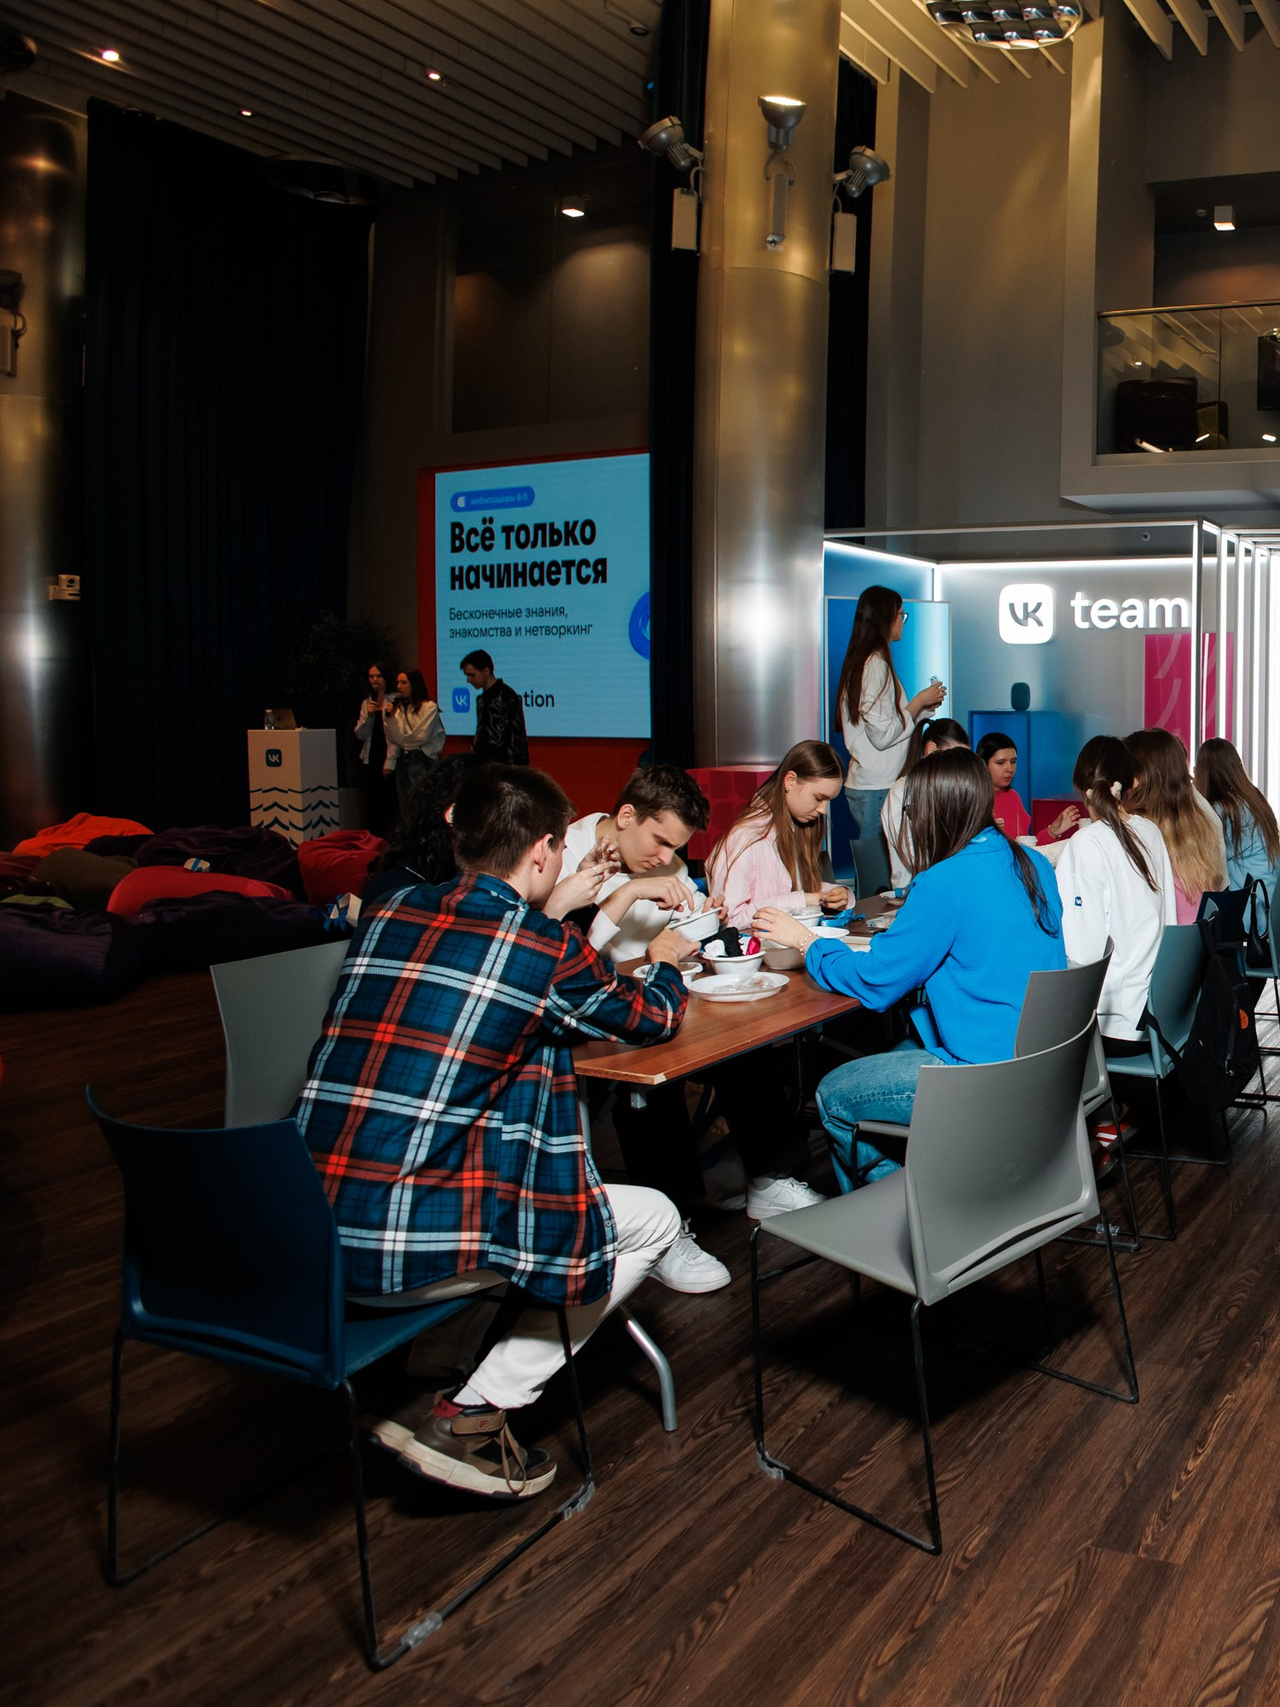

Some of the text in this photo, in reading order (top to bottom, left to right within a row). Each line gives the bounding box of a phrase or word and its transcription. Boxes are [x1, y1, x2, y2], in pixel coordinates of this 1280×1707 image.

[450, 516, 597, 553] Всё только
[450, 557, 608, 591] начинается
[449, 606, 568, 621] Бесконечные знания,
[1070, 591, 1190, 629] team
[449, 624, 593, 639] знакомства и нетворкинг
